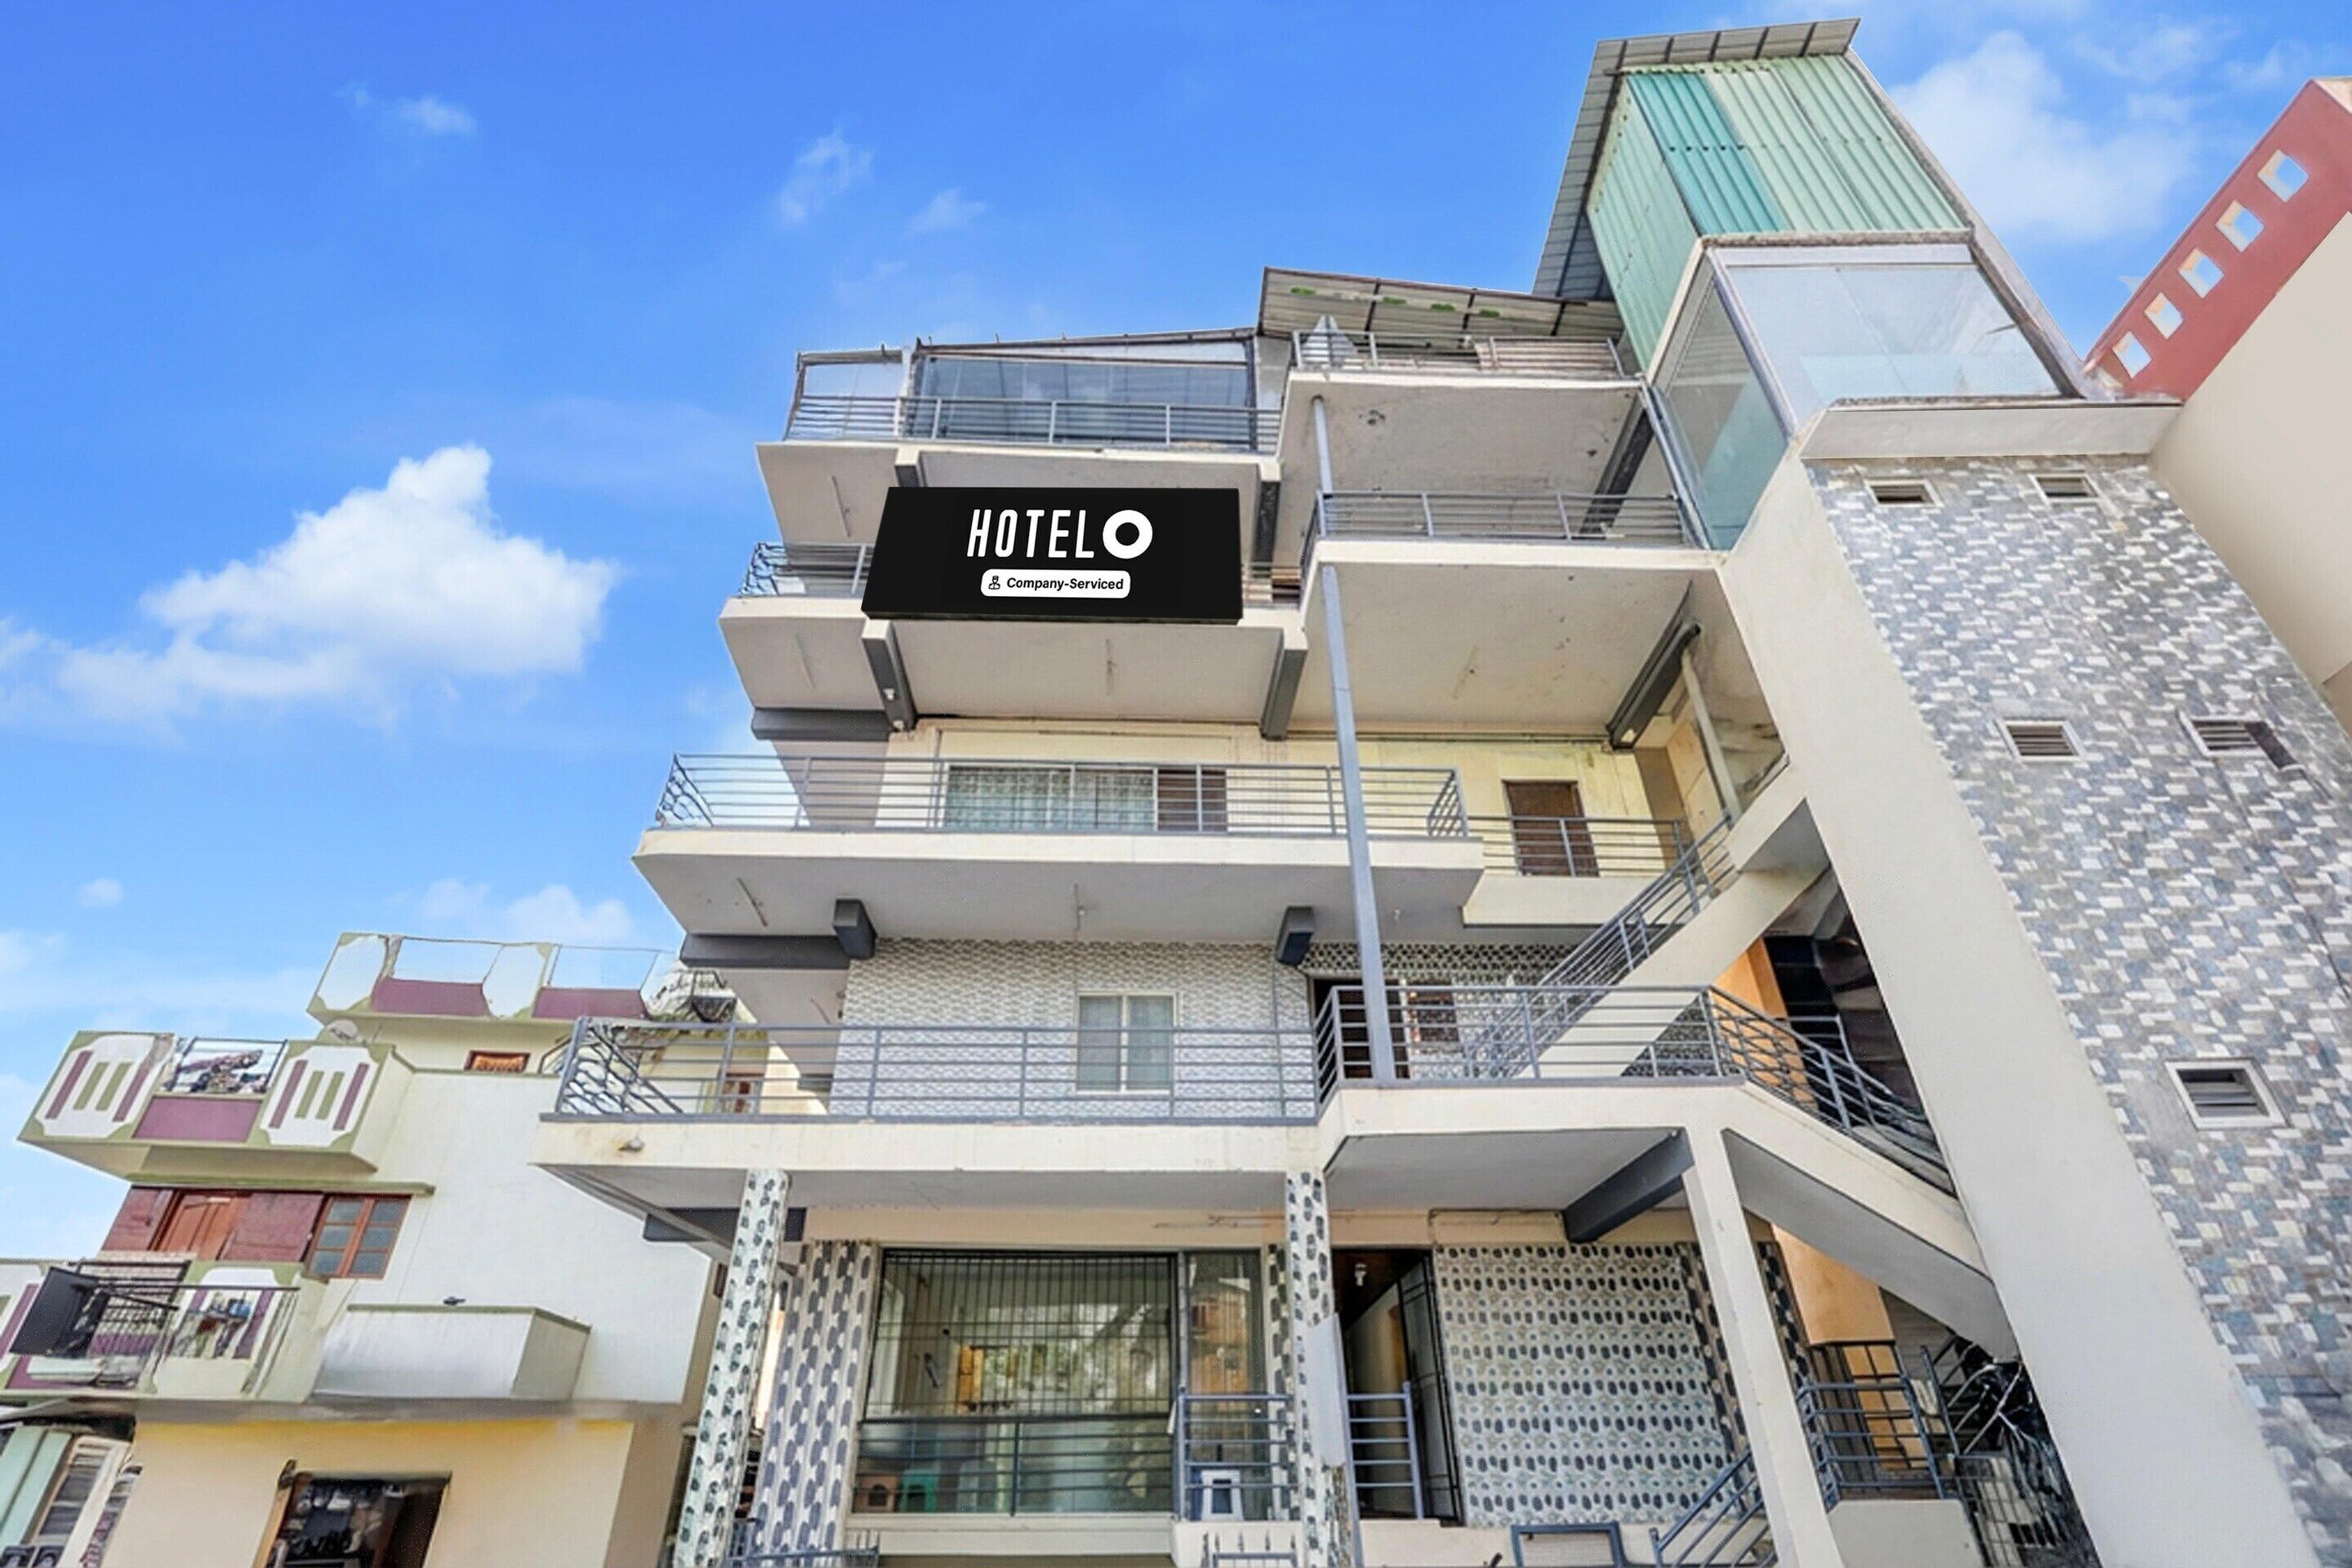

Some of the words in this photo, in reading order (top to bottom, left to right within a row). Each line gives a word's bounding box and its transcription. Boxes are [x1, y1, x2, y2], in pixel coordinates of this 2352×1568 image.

[967, 509, 1095, 559] HOTEL
[1102, 510, 1153, 559] O
[1006, 577, 1124, 591] Company-Serviced
